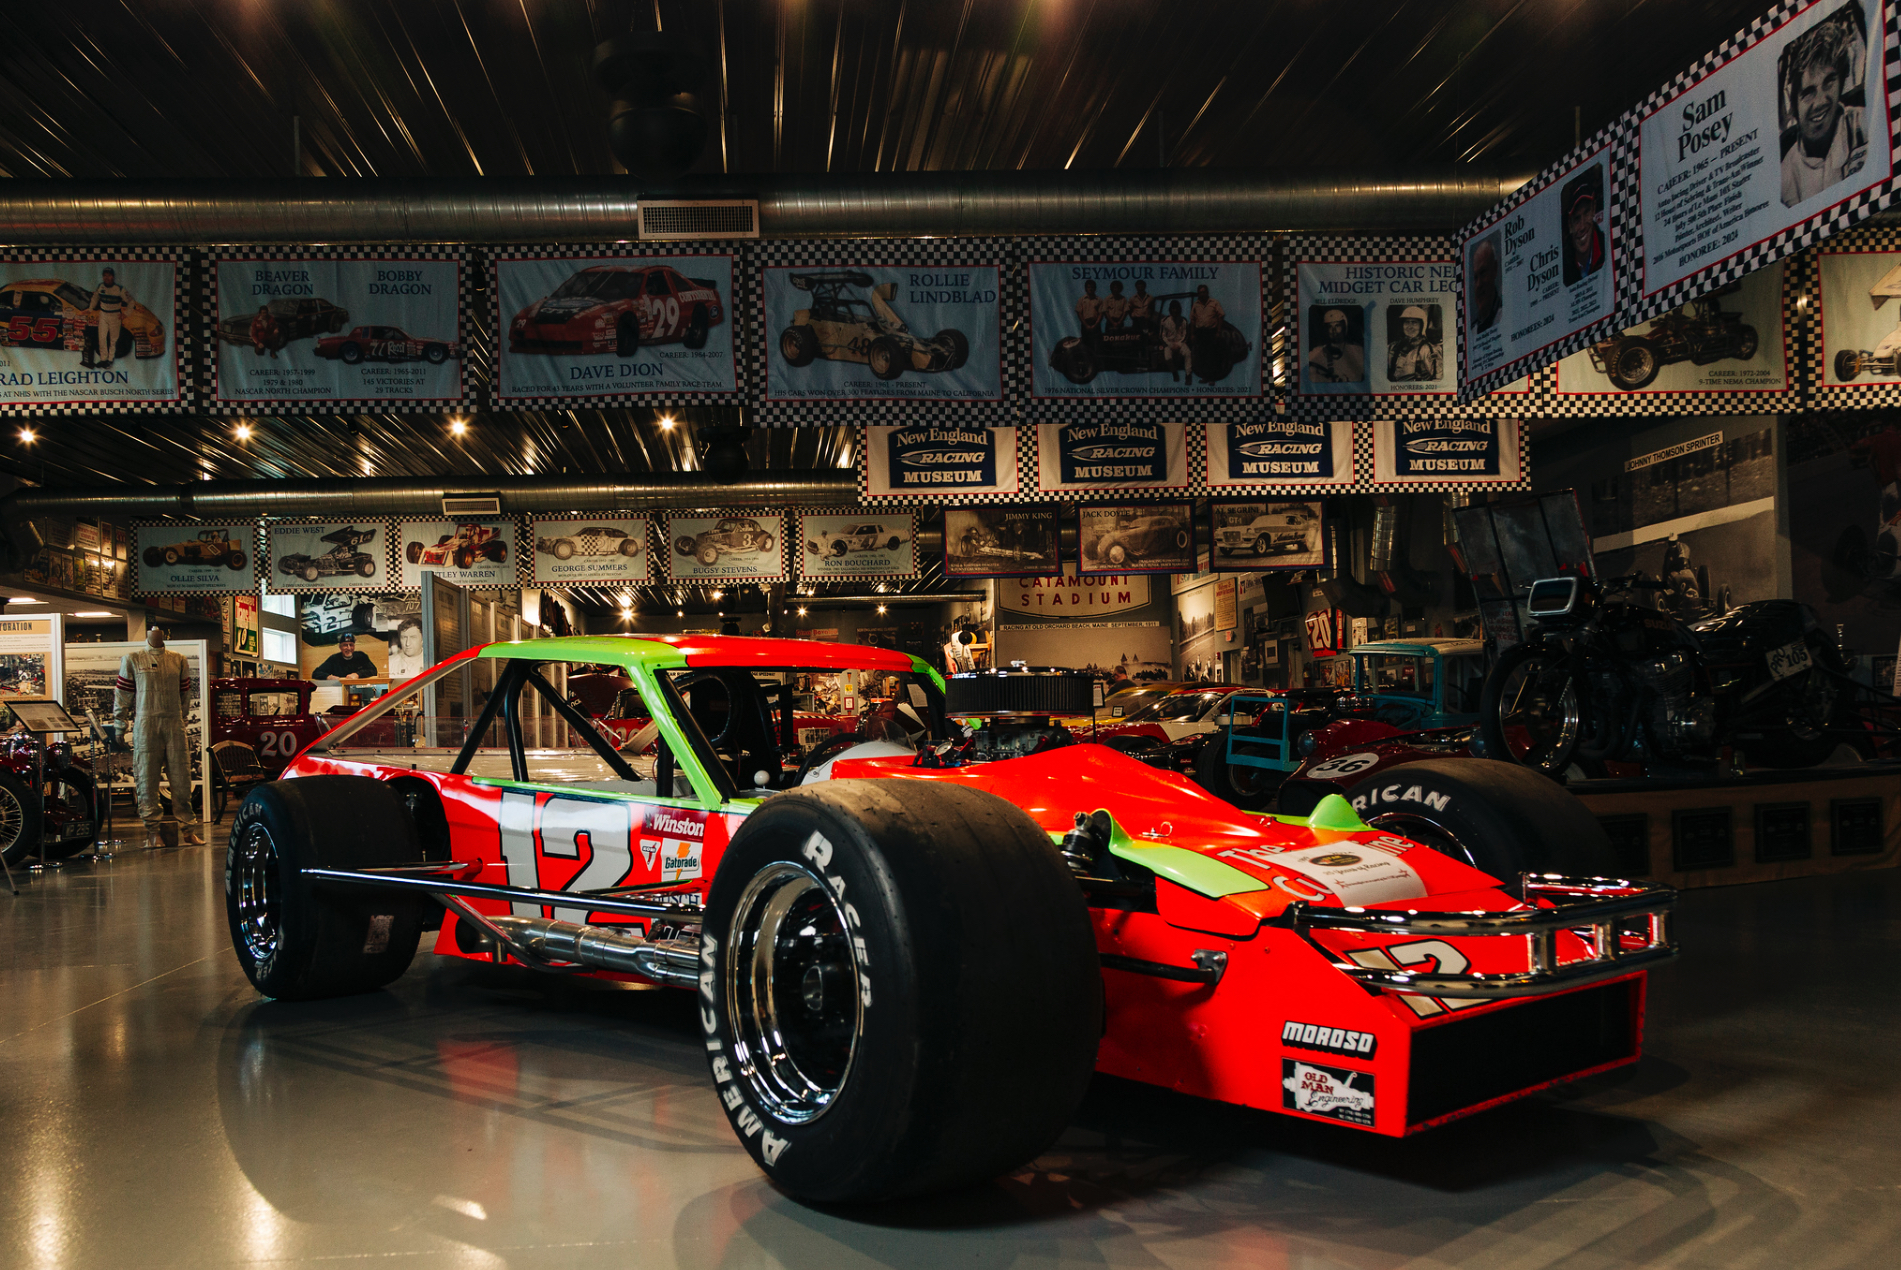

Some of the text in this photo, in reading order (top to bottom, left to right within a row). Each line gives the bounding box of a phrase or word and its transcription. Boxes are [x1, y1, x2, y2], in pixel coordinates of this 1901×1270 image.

[1682, 89, 1726, 133] Sam
[1678, 112, 1733, 162] Posey
[1693, 157, 1710, 175] 1965
[1720, 128, 1759, 159] PRESENT
[1504, 215, 1525, 240] Rob
[1505, 228, 1535, 256] Dyson
[1679, 229, 1739, 267] HONOREE: 2024
[1530, 244, 1559, 273] Chris
[255, 270, 310, 282] BEAVER
[377, 270, 423, 282] BOBBY
[910, 274, 970, 287] ROLLIE
[1072, 267, 1219, 280] SEYMOUR FAMILY
[1346, 266, 1425, 280] HISTORIC
[1527, 264, 1560, 292] Dyson
[252, 284, 313, 296] DRAGON
[369, 283, 432, 295] DRAGON
[1318, 281, 1425, 293] MIDGET CAR
[910, 290, 997, 303] LINDBLAD
[651, 297, 680, 340] 29
[8, 315, 61, 344] 55
[1511, 321, 1543, 342] HONOREES:
[847, 337, 871, 356] 48
[38, 370, 129, 385] LEIGHTON
[570, 363, 663, 380] DAVE DION
[292, 387, 332, 395] CHAMPION
[612, 381, 655, 389] VOLUNTEER
[13, 390, 32, 398] NHIS
[69, 388, 99, 396] NASCAR
[100, 388, 124, 396] BUSCH
[125, 388, 151, 396] NORTH
[1067, 423, 1159, 442] New England
[1235, 421, 1325, 438] New England
[1402, 419, 1492, 435] New England
[896, 427, 988, 447] New England
[1091, 446, 1156, 458] RACING
[1258, 442, 1323, 455] RACING
[1424, 440, 1488, 452] RACING
[1627, 434, 1720, 470] JOHNNY THOMSON SPRINTER
[920, 451, 986, 464] RACING
[1409, 459, 1486, 471] MUSEUM
[1074, 465, 1153, 478] MUSEUM
[1242, 461, 1320, 474] MUSEUM
[903, 470, 983, 483] MUSEUM
[1005, 512, 1053, 521] JIMMY KING
[1082, 510, 1102, 519] JACK
[1227, 506, 1259, 514] SEGRINI
[274, 527, 300, 535] EDDIE
[1019, 575, 1128, 588] CATAMOUNT
[1021, 592, 1131, 607] STADIUM
[1770, 648, 1808, 674] PRO 105
[260, 731, 298, 758] 20
[1316, 759, 1370, 773] 36
[1351, 782, 1451, 813] RICAN
[653, 813, 705, 838] Winston
[225, 802, 263, 896] AMERICAN
[499, 791, 648, 938] 12
[664, 855, 698, 870] Gatorade
[802, 829, 873, 1008] RACER
[1345, 939, 1493, 1019] 12
[1283, 1021, 1374, 1053] MOROSO
[699, 932, 793, 1168] AMERICAN
[1304, 1072, 1328, 1084] OLD
[1301, 1081, 1334, 1095] MAN
[1305, 1091, 1364, 1108] Engineering
